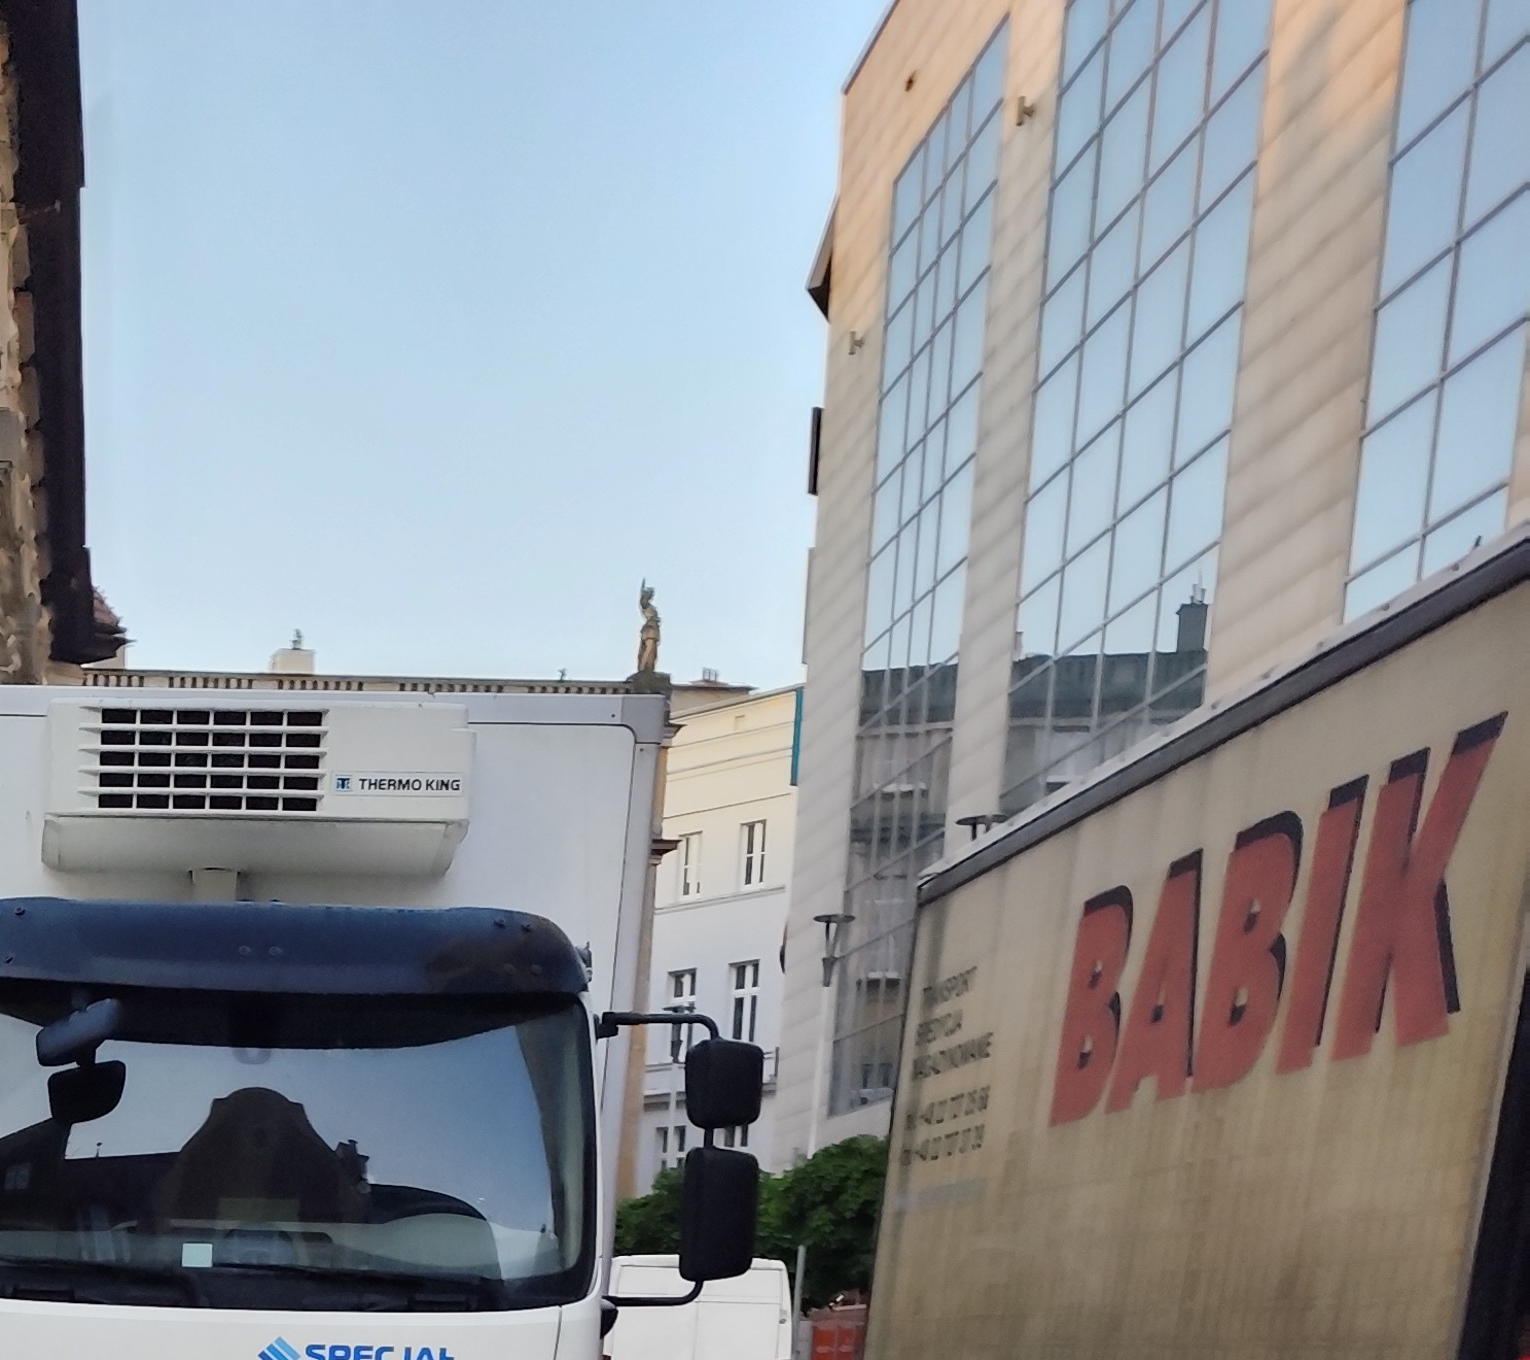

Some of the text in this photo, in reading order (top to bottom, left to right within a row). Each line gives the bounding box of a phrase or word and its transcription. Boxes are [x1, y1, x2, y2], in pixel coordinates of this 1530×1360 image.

[358, 778, 461, 791] THERMO KING
[1048, 710, 1509, 1127] BABIK
